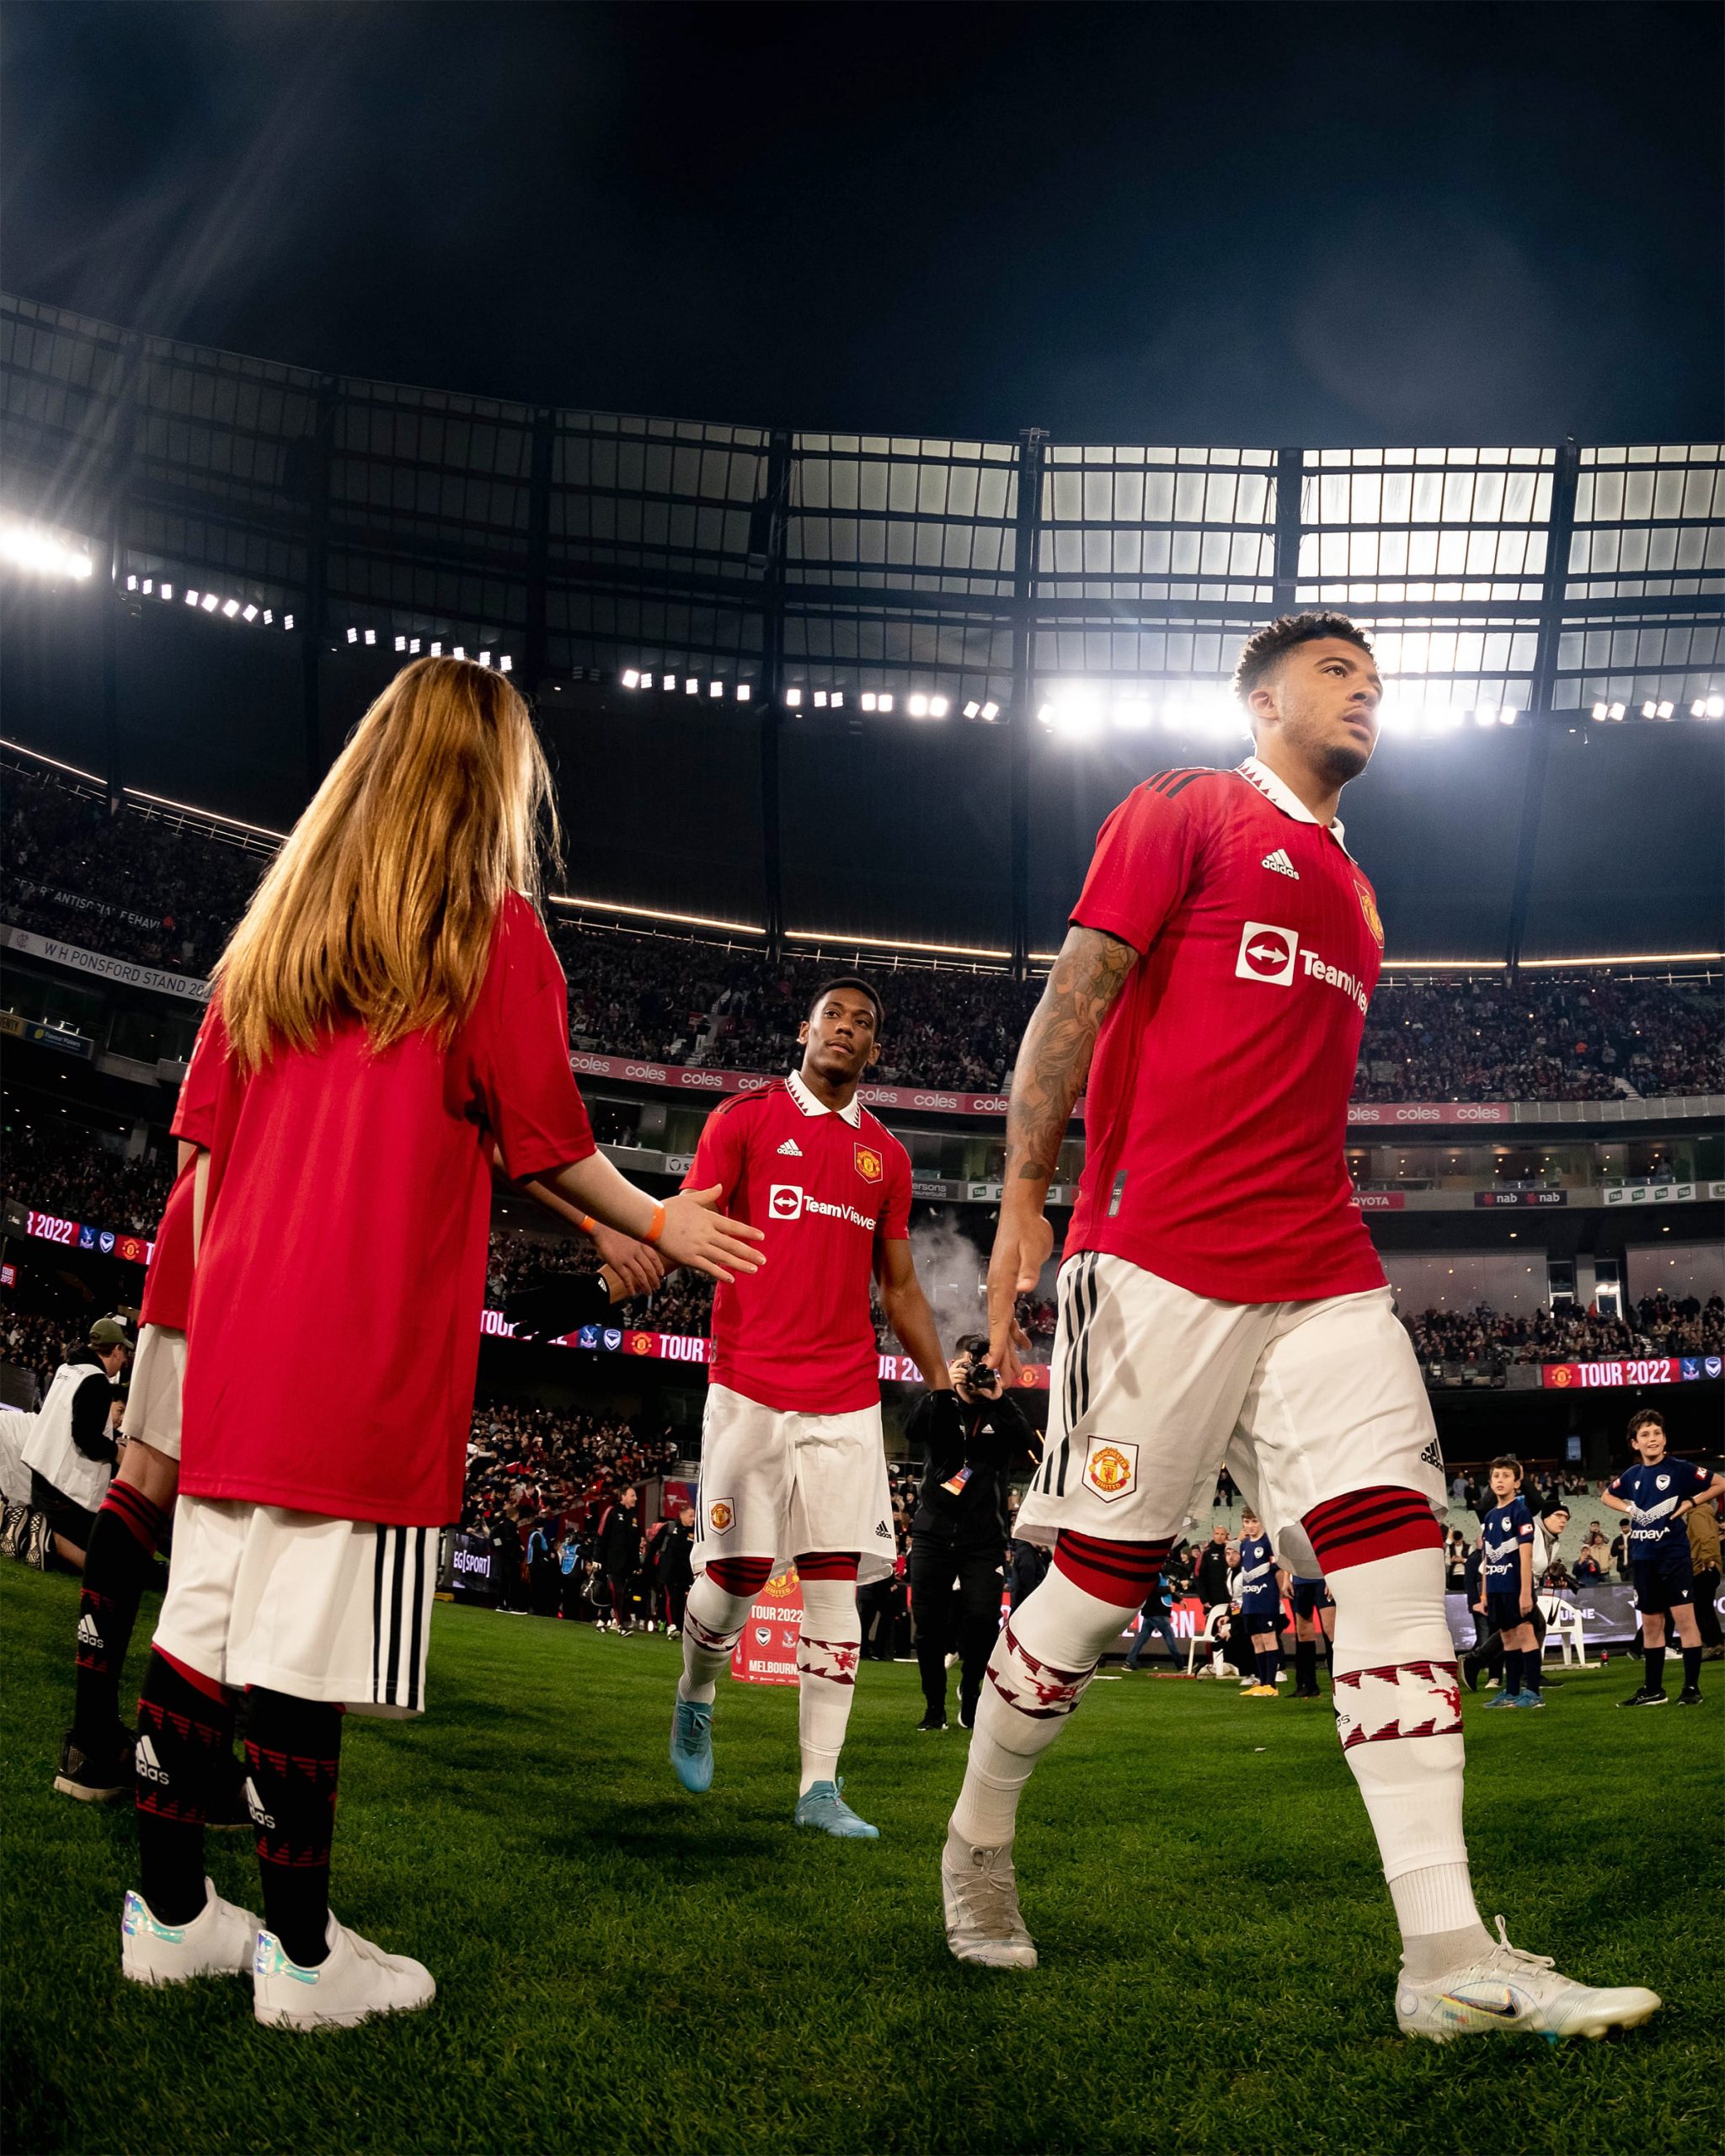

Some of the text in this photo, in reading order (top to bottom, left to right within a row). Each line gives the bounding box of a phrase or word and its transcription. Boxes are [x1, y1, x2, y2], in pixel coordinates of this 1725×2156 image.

[1261, 859, 1300, 881] adidas
[44, 942, 59, 955] W
[58, 947, 69, 961] H
[71, 951, 141, 982] PONSFORD
[143, 971, 186, 993] STAND
[1299, 949, 1369, 1017] TeamVie
[570, 1056, 770, 1091] coles coles coles col
[856, 1088, 1008, 1112] coles coles cole
[1347, 1105, 1501, 1121] oles coles coles
[777, 1148, 804, 1157] adidas
[912, 1182, 947, 1193] ersons
[1496, 1192, 1560, 1203] nab nab
[1352, 1196, 1390, 1206] OYOTA
[35, 1214, 73, 1245] 2022
[659, 1334, 704, 1363] TOUR
[1578, 1359, 1671, 1387] TOUR 2022
[1096, 1480, 1121, 1490] UNITED
[765, 1583, 790, 1595] UNITED
[751, 1604, 803, 1624] TOUR 2022
